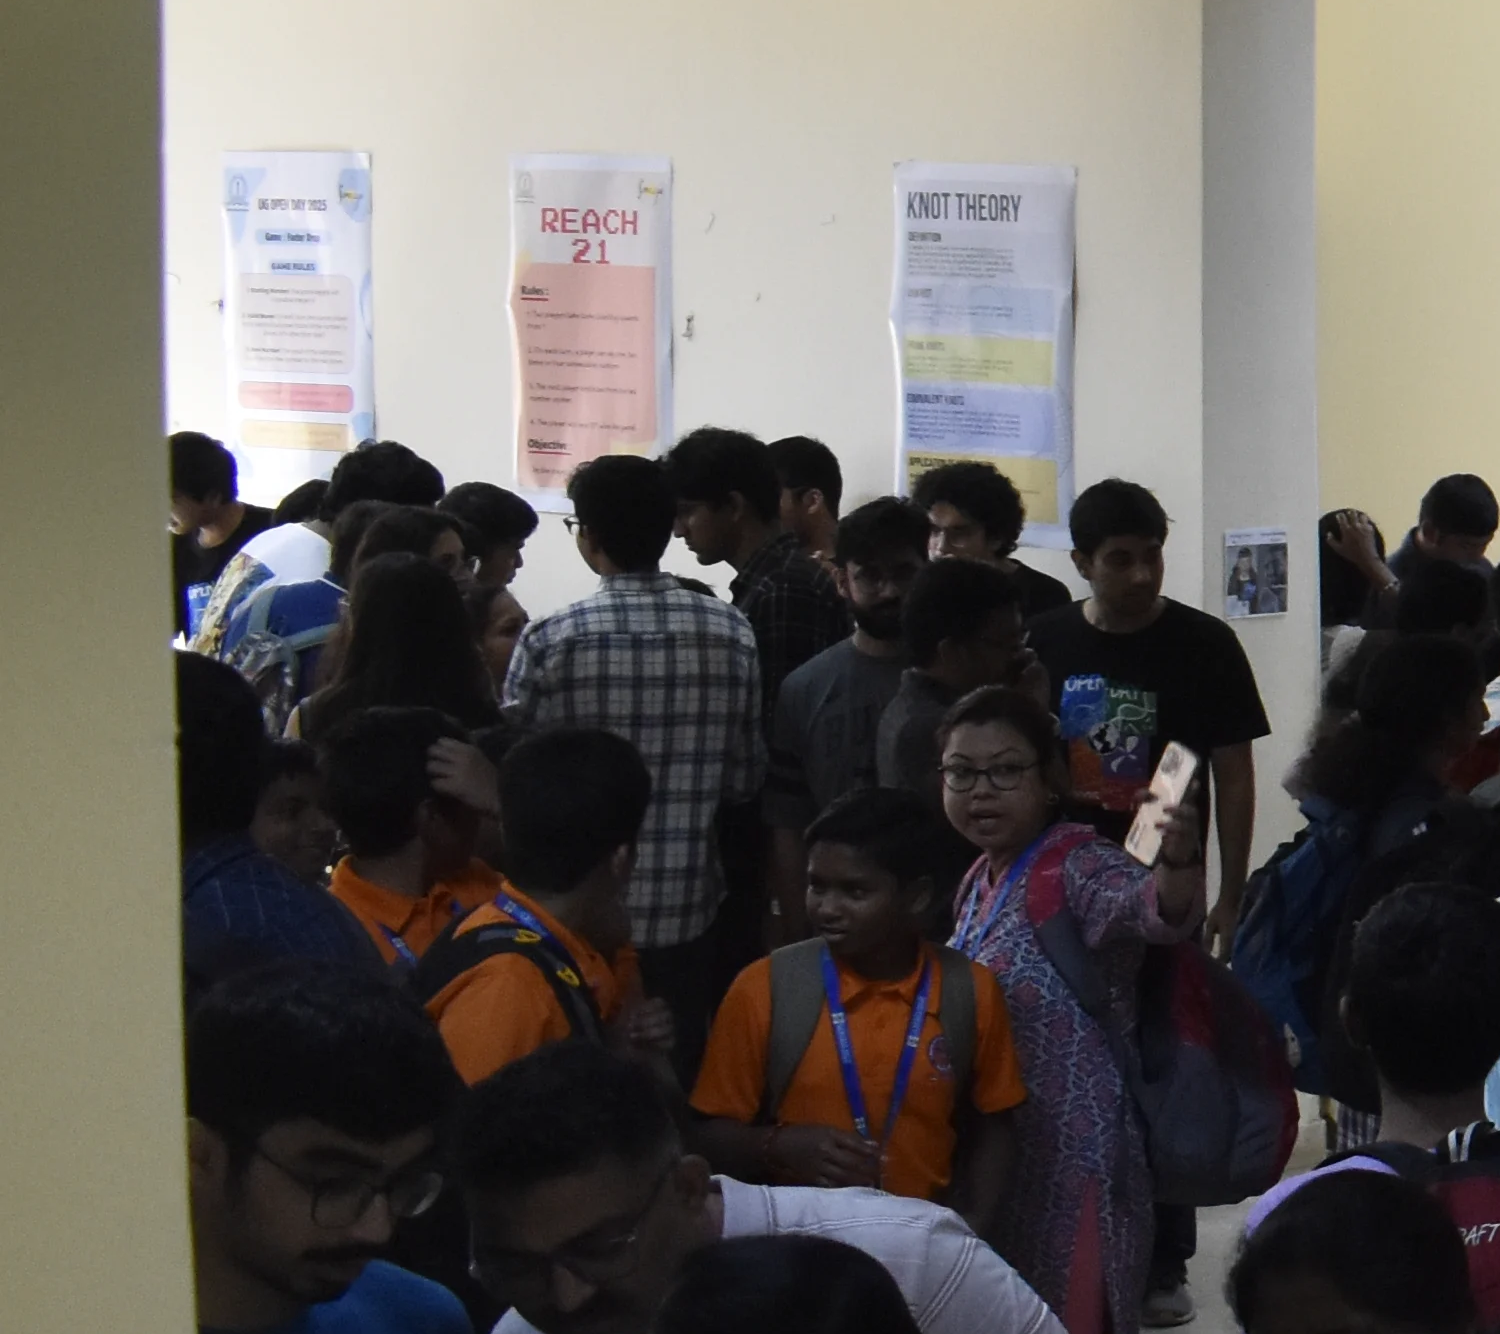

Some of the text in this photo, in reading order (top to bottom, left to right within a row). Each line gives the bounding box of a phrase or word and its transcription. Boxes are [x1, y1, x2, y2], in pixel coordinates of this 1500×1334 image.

[906, 191, 1022, 222] KNOT THEORY
[540, 207, 639, 236] REACH
[571, 238, 610, 264] 21
